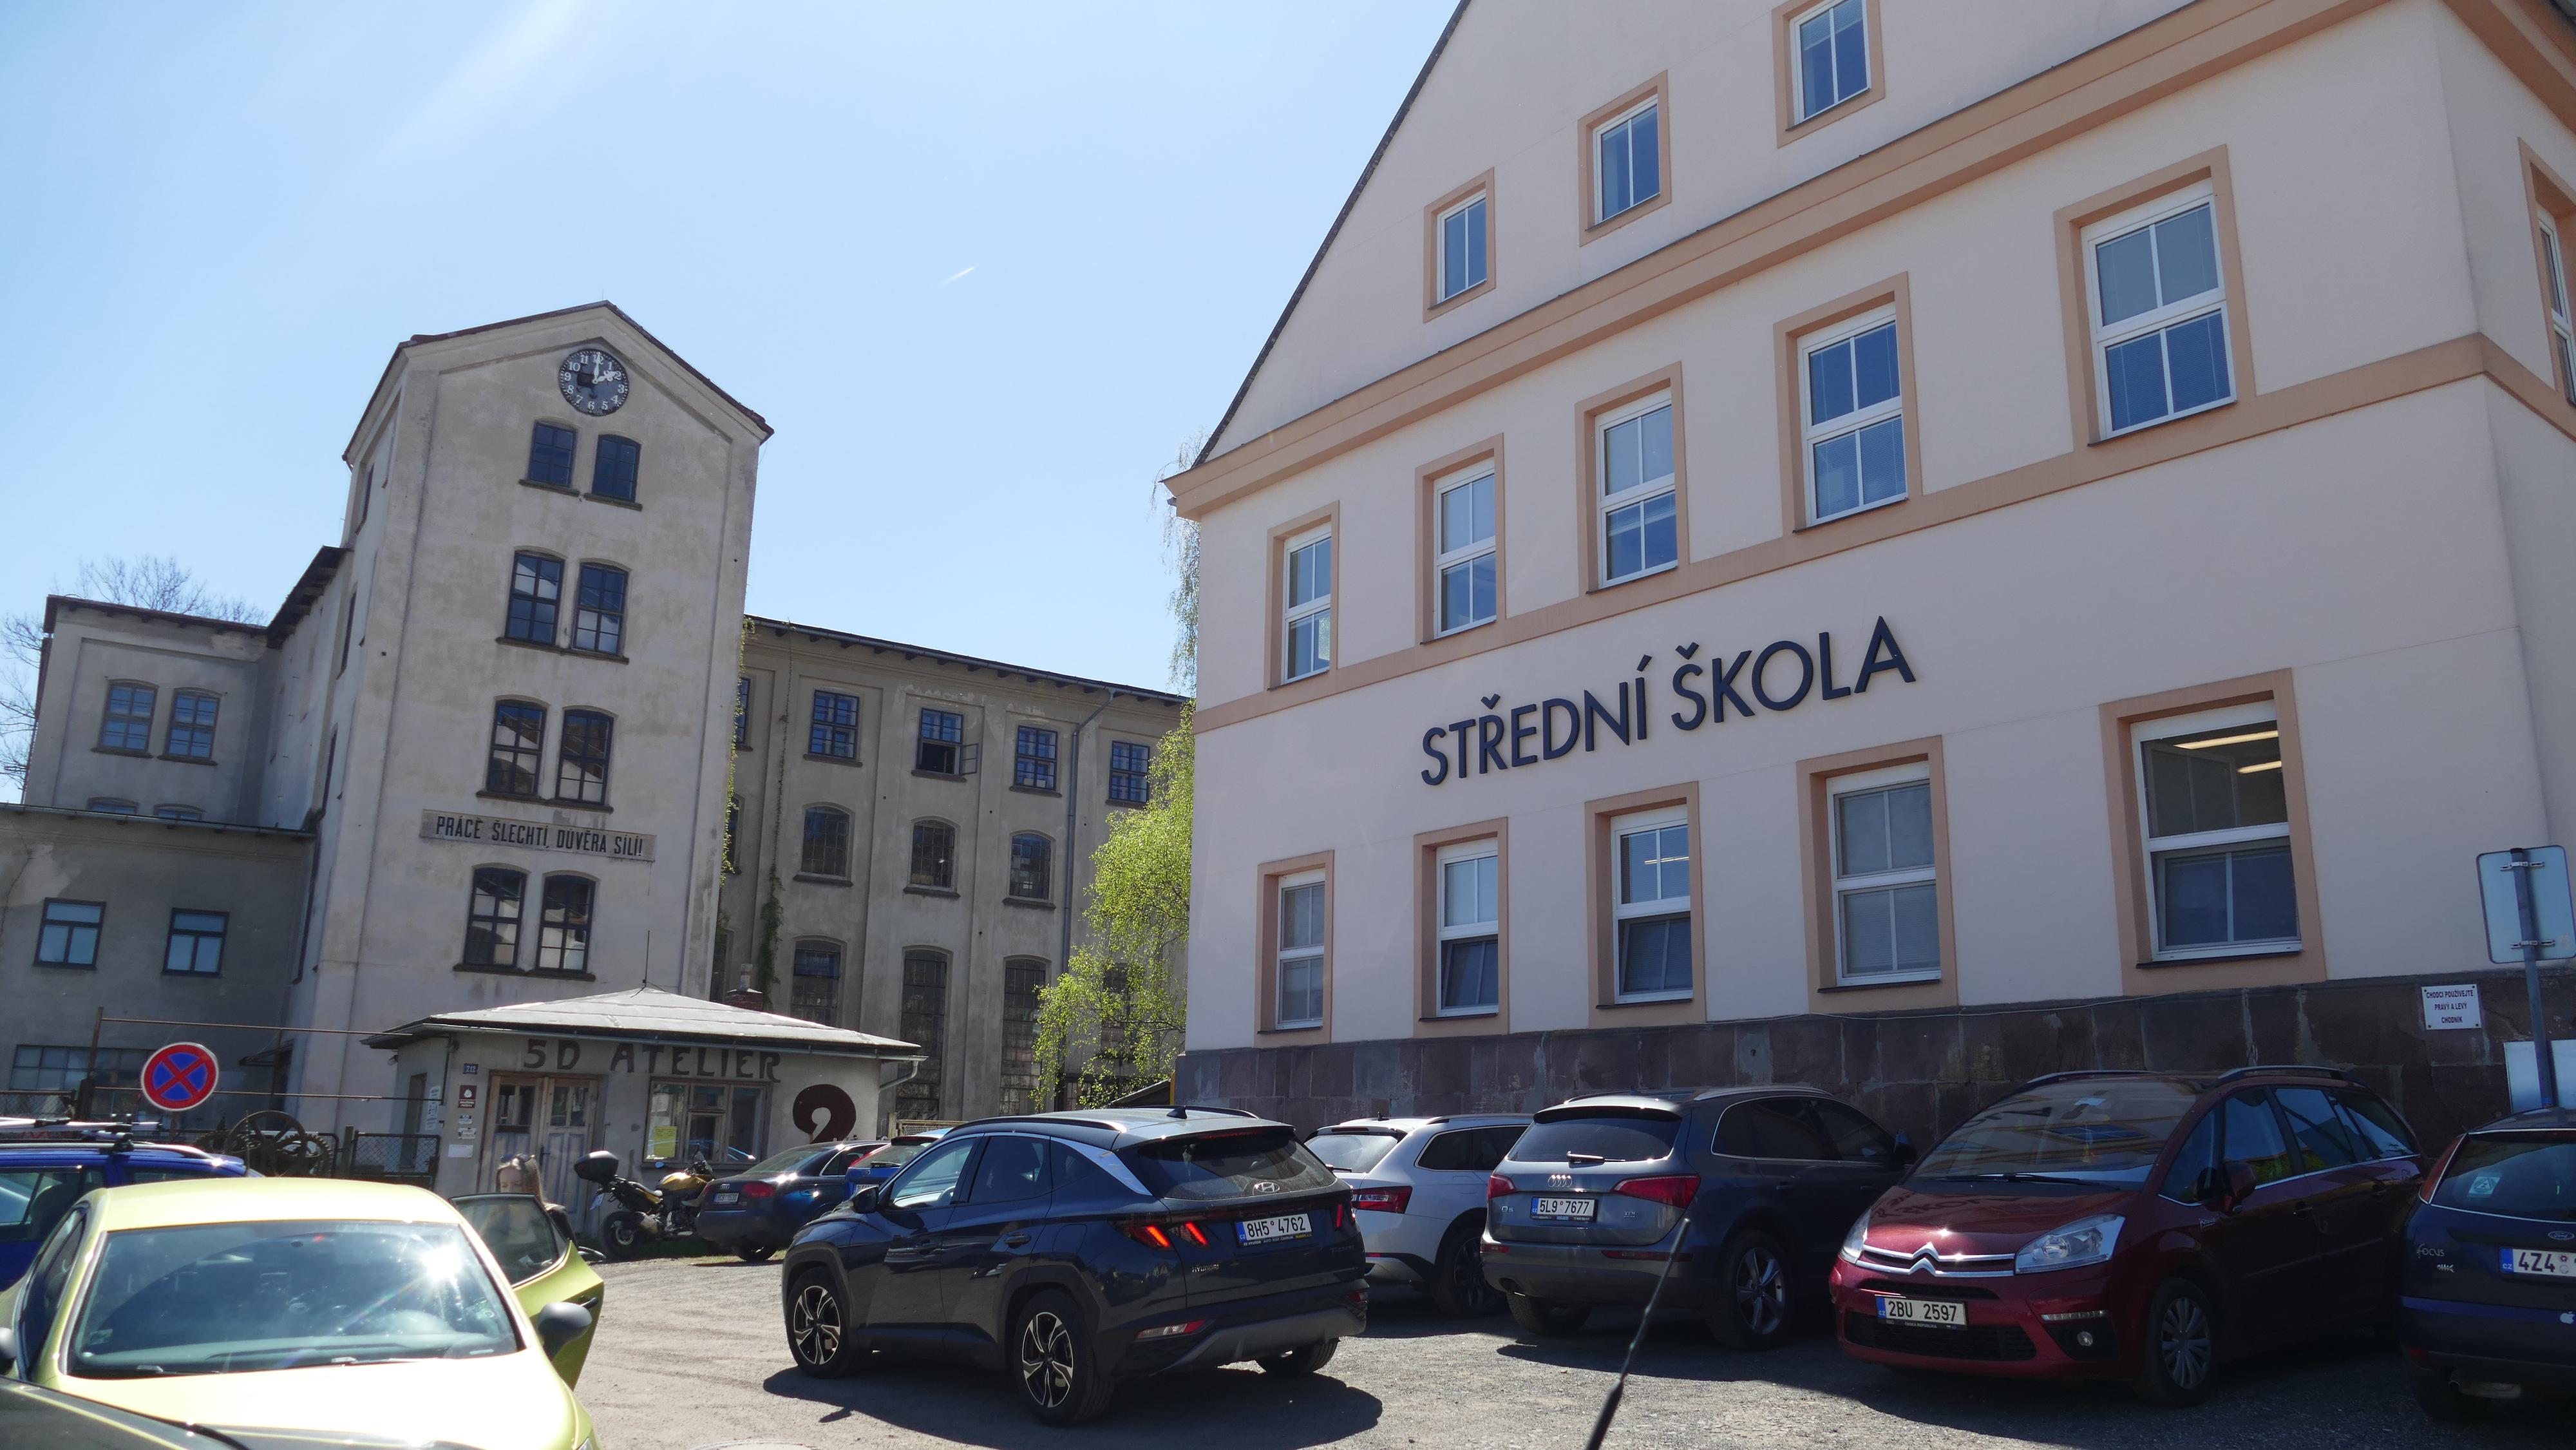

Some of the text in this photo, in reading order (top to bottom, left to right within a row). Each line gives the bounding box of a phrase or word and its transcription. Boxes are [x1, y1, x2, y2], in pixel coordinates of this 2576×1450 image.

[569, 361, 580, 372] 10
[564, 372, 571, 381] 9
[567, 385, 574, 394] 8
[618, 384, 625, 394] 3
[576, 395, 583, 404] 7
[611, 395, 619, 404] 4
[587, 401, 595, 410] 6
[601, 401, 609, 410] 5
[1421, 616, 1916, 786] STŘEDNÍ ŠKOLA
[436, 816, 643, 856] PRÁCE ŠLECHTÍ, DŮVĚRA SÍLÍ!
[2445, 989, 2474, 998] POUŽÍVEJTE
[2434, 1002, 2450, 1010] PRAVÝ
[2456, 1002, 2467, 1010] LEVÝ
[524, 1039, 781, 1083] 5D ATELIER
[1540, 1200, 1589, 1214] 5L9 7677
[1247, 1216, 1306, 1237] 8H5 4762
[2519, 1252, 2555, 1272] 4Z4
[1888, 1301, 1957, 1322] 2BU 2597
